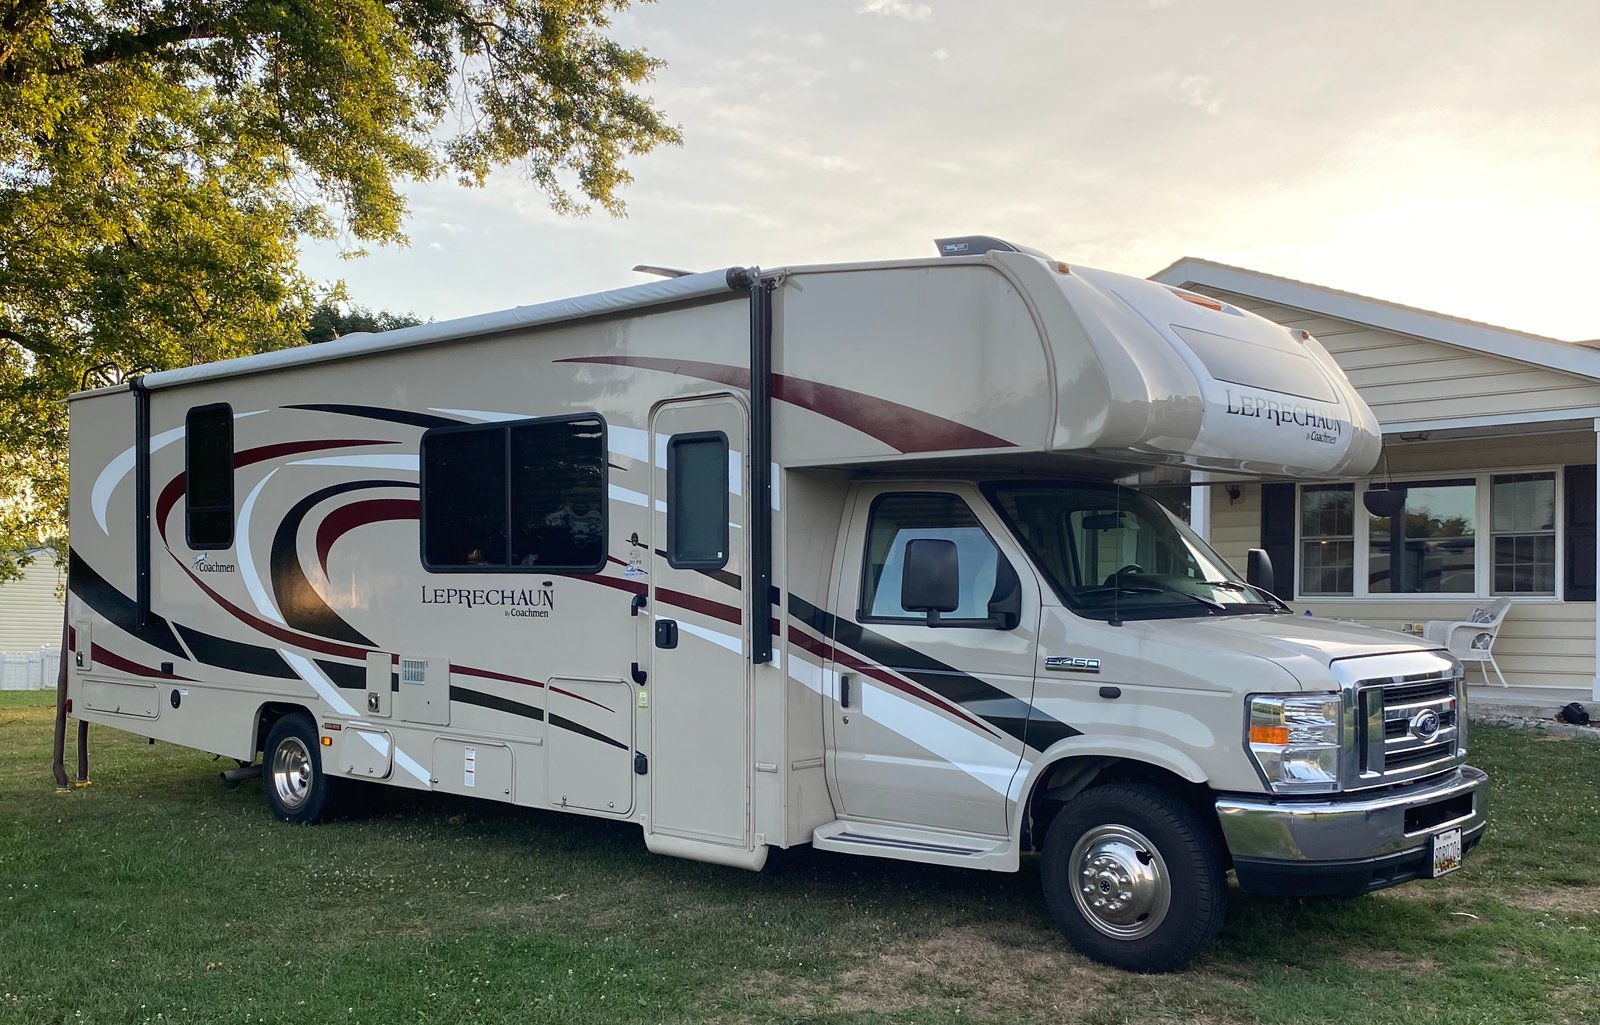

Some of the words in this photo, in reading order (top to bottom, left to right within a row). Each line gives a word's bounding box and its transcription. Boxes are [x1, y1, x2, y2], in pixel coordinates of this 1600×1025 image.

[1225, 389, 1341, 437] LEPRECHAUN
[1311, 430, 1337, 444] Coachmen
[199, 561, 235, 573] Coachmen
[421, 585, 554, 611] LEPRECHAUN
[510, 608, 549, 618] Coachmen
